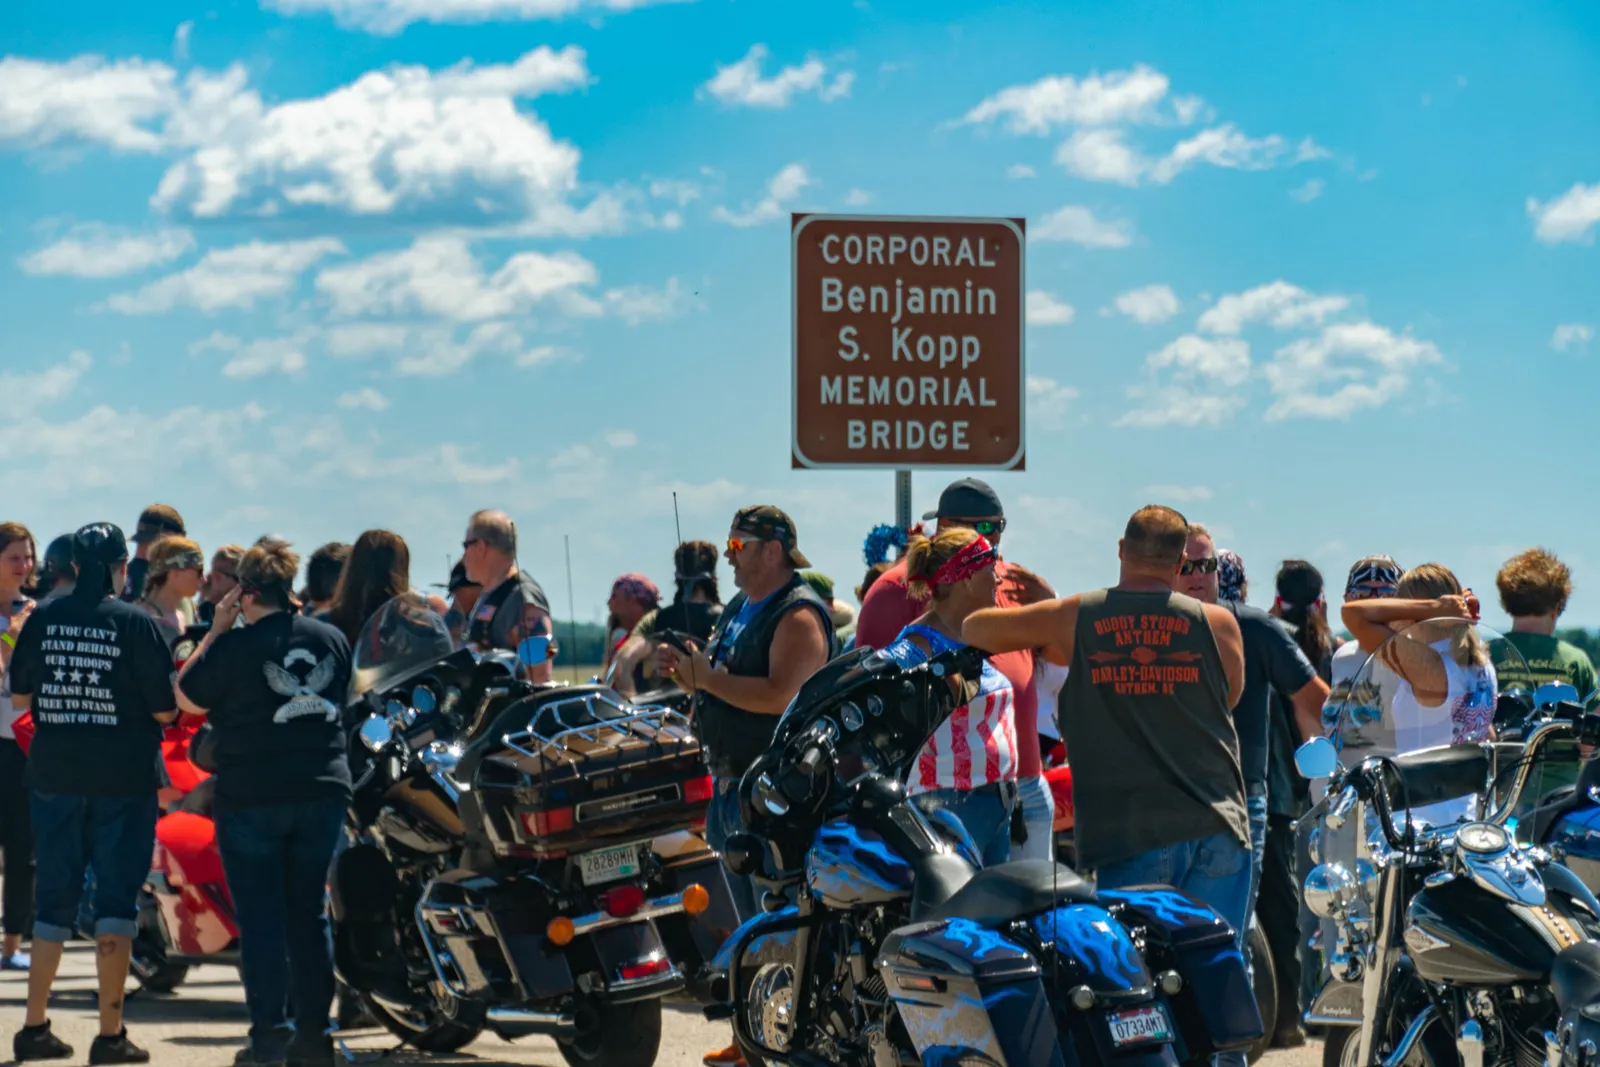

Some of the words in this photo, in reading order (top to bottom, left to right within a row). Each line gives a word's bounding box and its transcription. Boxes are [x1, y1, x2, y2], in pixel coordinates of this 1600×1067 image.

[821, 234, 996, 267] CORPORAL
[821, 277, 997, 324] Benjamin
[838, 325, 870, 361] S.
[891, 327, 981, 369] Kopp
[820, 375, 997, 407] MEMORIAL
[847, 420, 970, 450] BRIDGE
[46, 624, 58, 636] IF
[59, 624, 82, 637] YOU
[83, 626, 118, 642] CAN'T
[1093, 615, 1134, 635] BUDDY
[1141, 615, 1191, 635] STUBBS
[1115, 630, 1171, 646] ANTHEM
[41, 639, 75, 652] STAND
[76, 641, 121, 658] BEHIND
[44, 654, 66, 666] OUR
[68, 655, 113, 671] TROOPS
[1091, 666, 1199, 684] HARLEY-DAVIDSON
[41, 683, 82, 696] PLEASE
[84, 686, 113, 700] FEEL
[38, 697, 63, 710] FREE
[64, 699, 80, 710] TO
[81, 699, 116, 713] STAND
[47, 712, 76, 724] FRONT
[77, 713, 90, 724] OF
[91, 713, 118, 726] THEM
